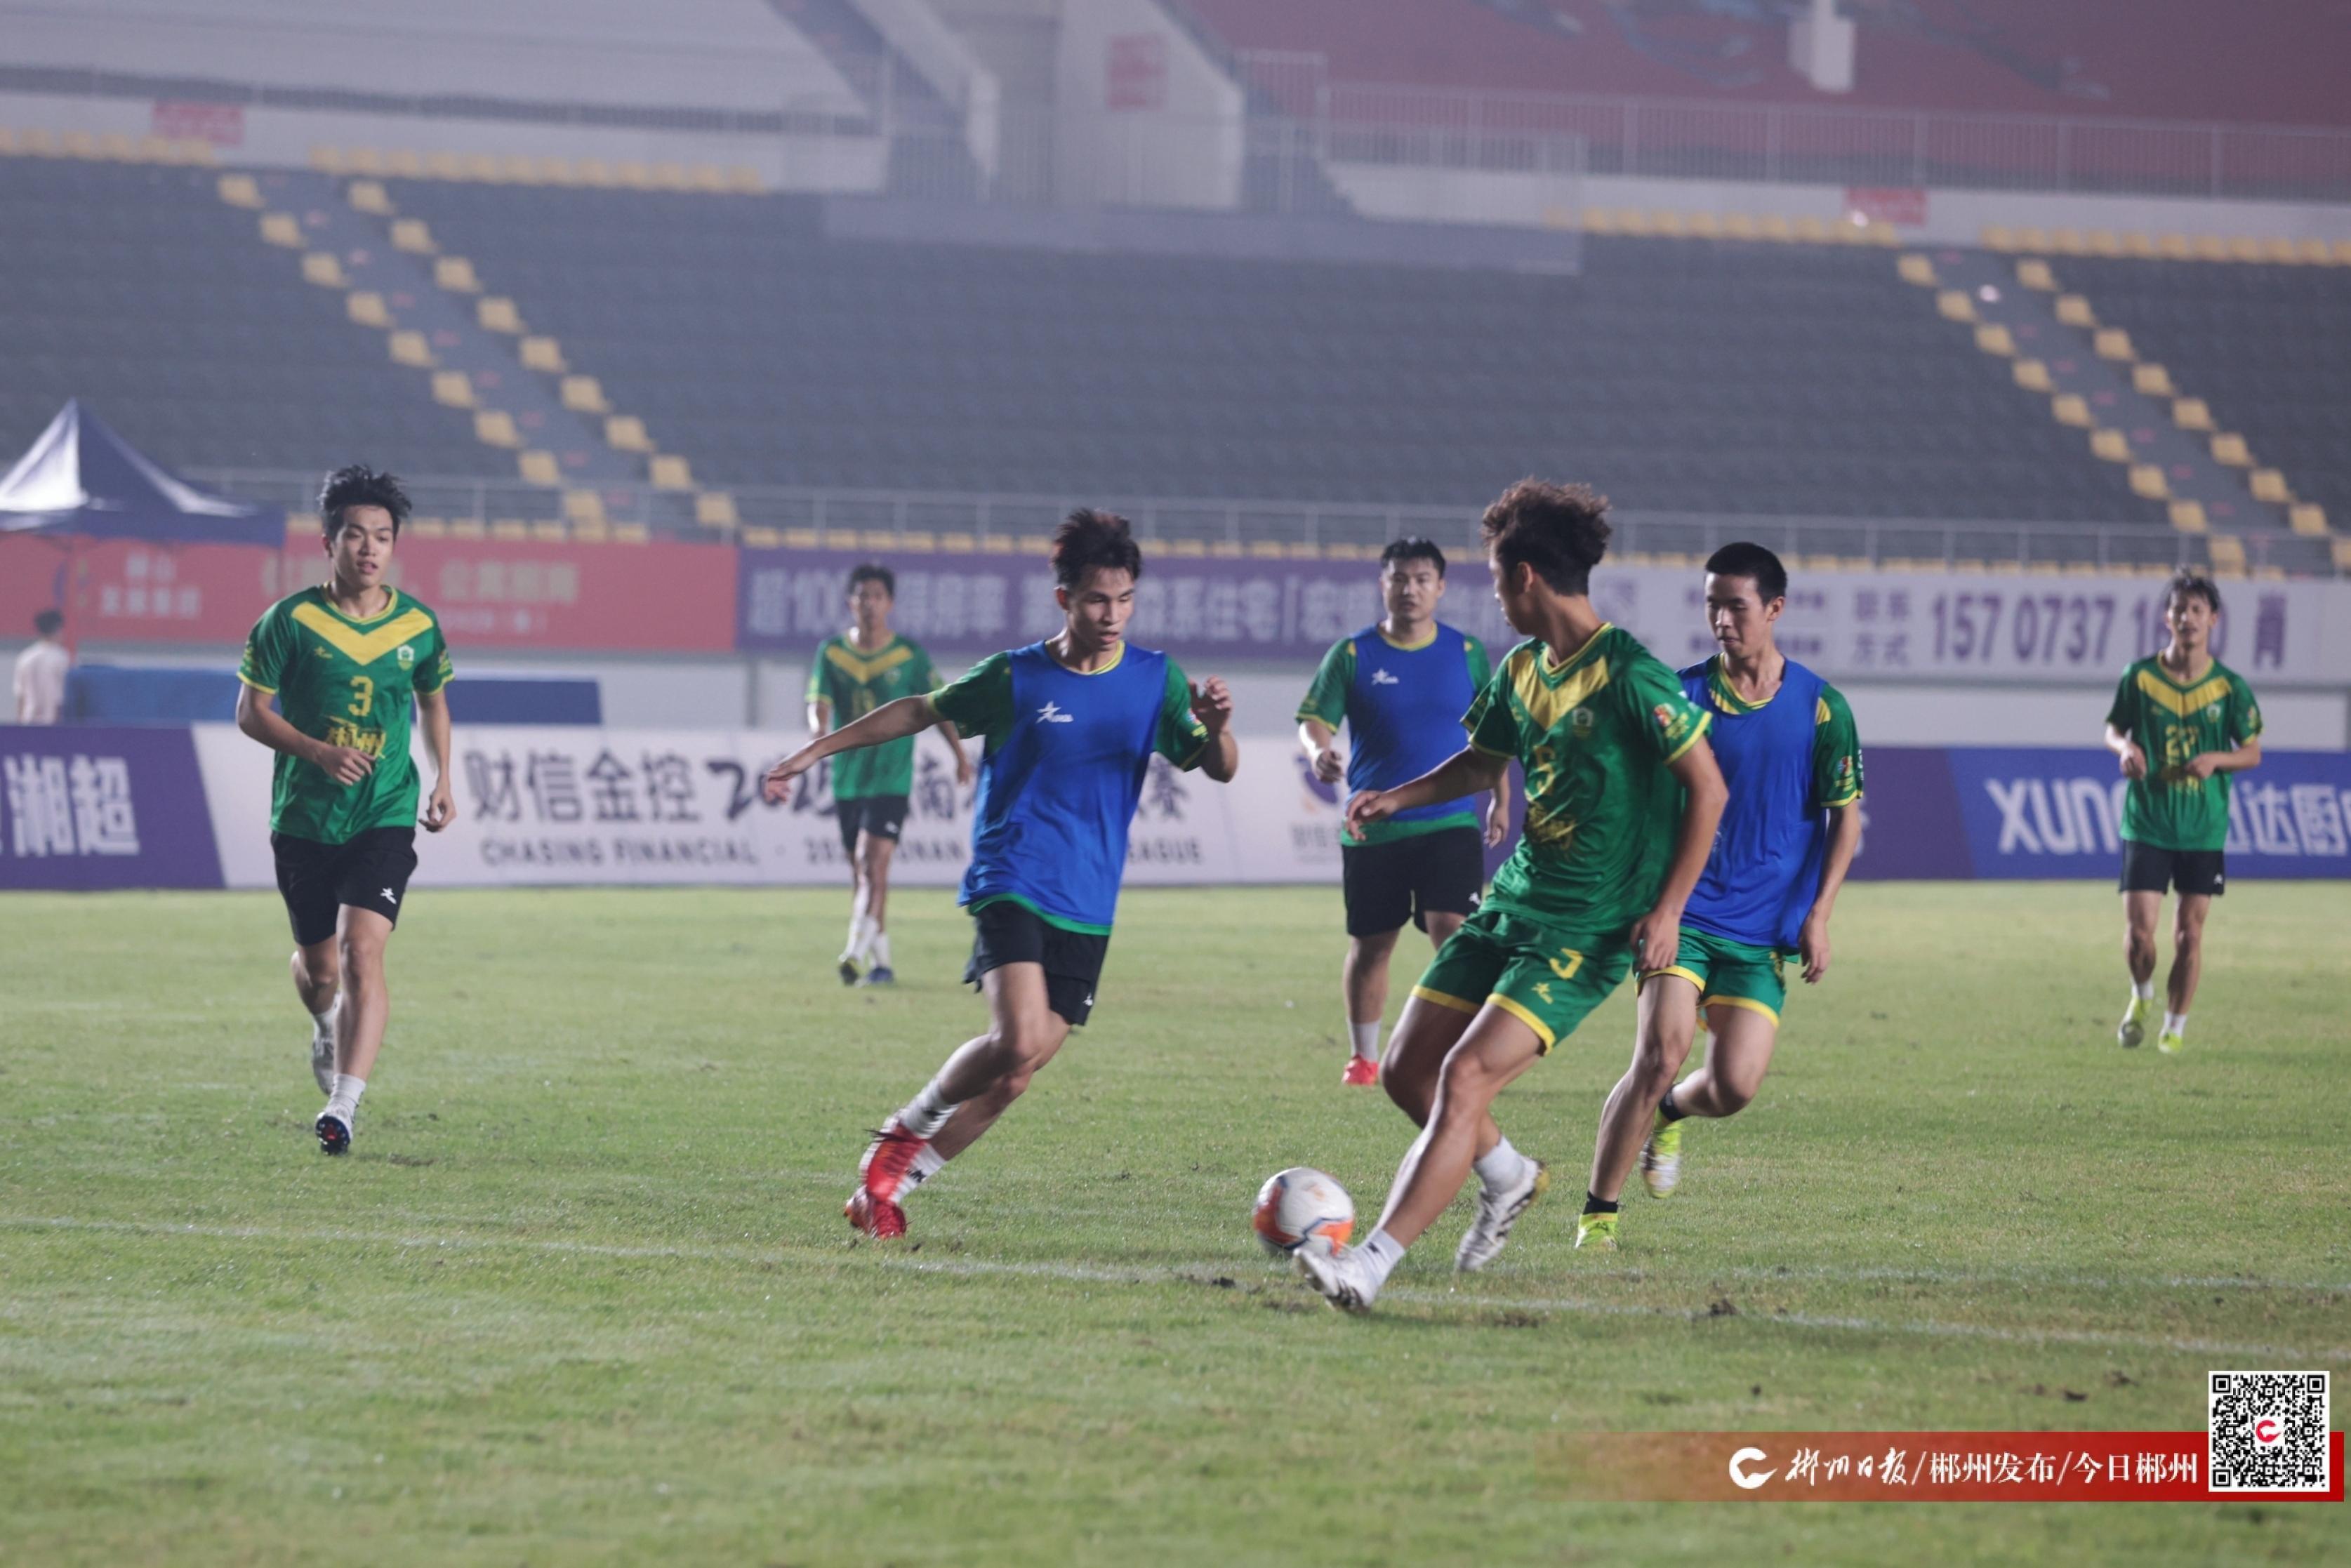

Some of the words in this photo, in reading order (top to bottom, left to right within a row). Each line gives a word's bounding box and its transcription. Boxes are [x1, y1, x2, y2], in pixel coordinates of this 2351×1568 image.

[1932, 594, 2000, 663] 157
[2013, 594, 2114, 663] 0737
[348, 675, 373, 717] 3
[4, 752, 140, 858] 湘超
[464, 749, 702, 823] 财信金控
[481, 839, 604, 866] CHASING
[612, 839, 760, 866] FINANCIAL
